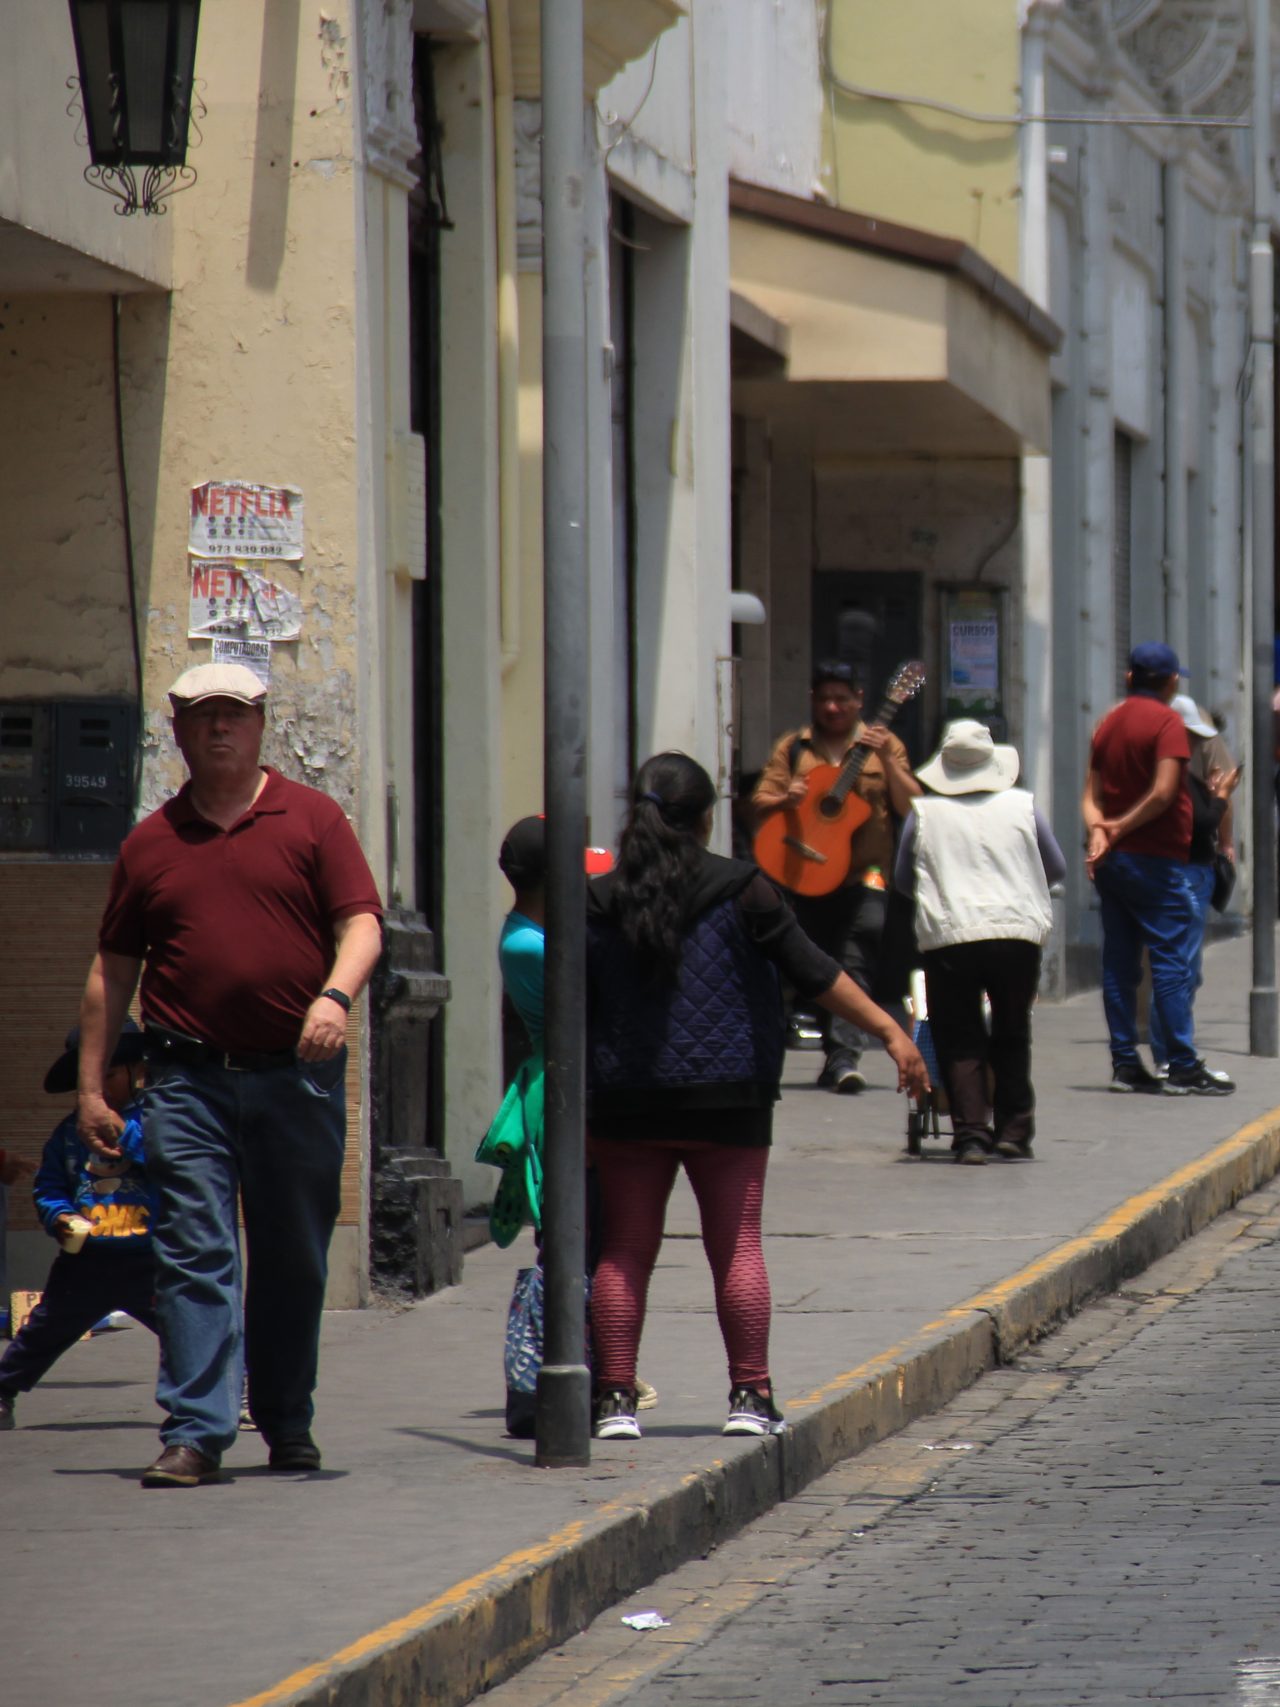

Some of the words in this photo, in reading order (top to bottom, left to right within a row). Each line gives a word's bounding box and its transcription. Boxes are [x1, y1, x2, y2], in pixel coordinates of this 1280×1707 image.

[191, 487, 293, 520] NETFLIX
[952, 625, 996, 637] CURSOS
[214, 639, 269, 657] COMPUTADORAS
[65, 774, 107, 789] 39549
